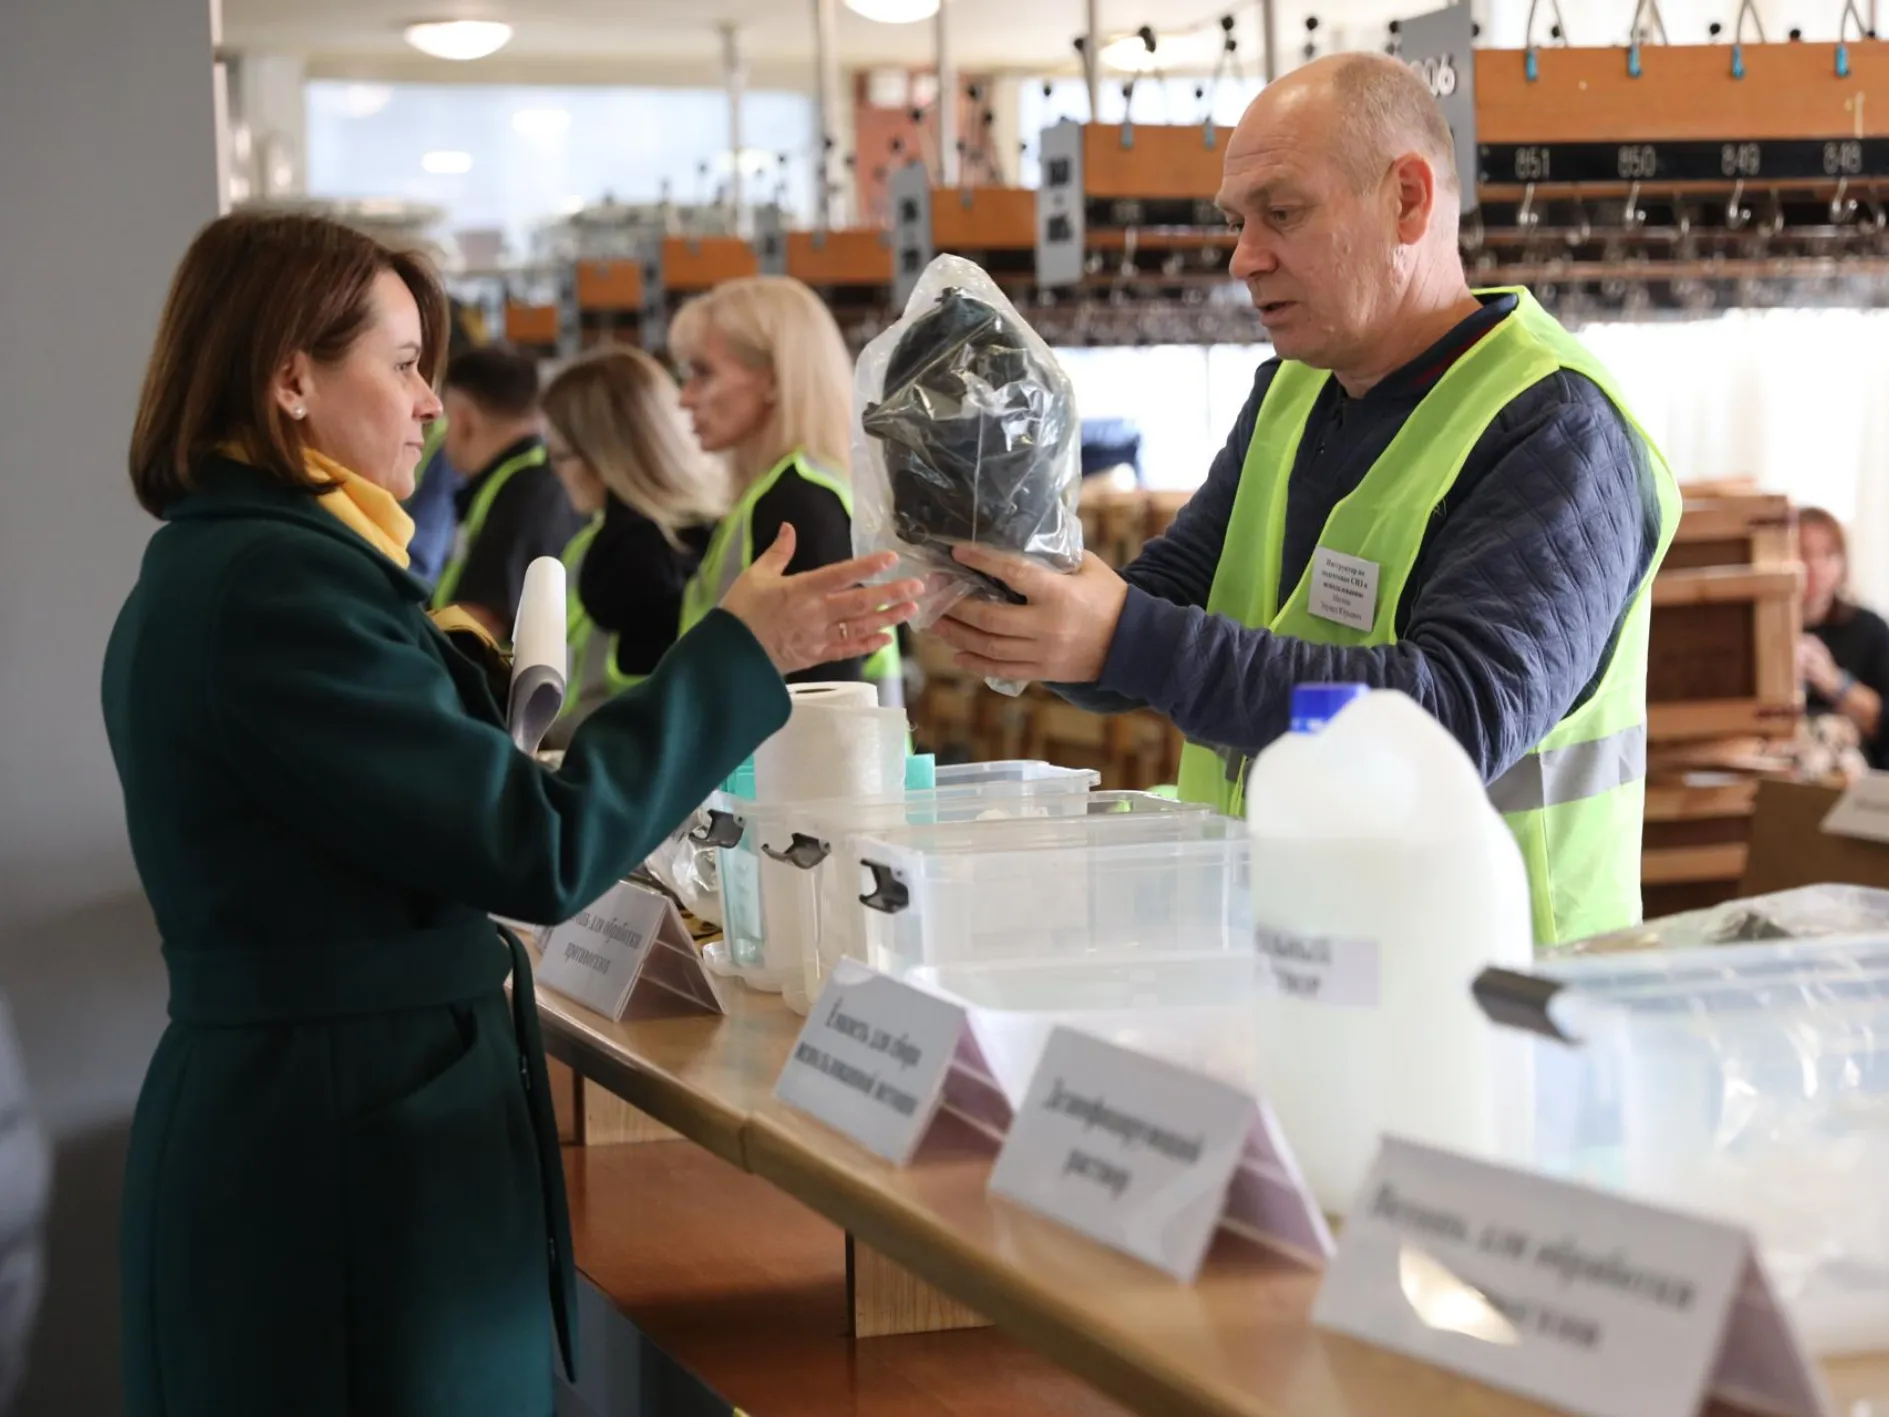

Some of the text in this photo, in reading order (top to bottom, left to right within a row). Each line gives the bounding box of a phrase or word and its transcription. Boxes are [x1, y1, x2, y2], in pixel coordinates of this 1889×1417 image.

[1515, 147, 1550, 179] 851
[1618, 145, 1657, 178] 850
[1721, 143, 1760, 176] 849
[1823, 140, 1862, 174] 848
